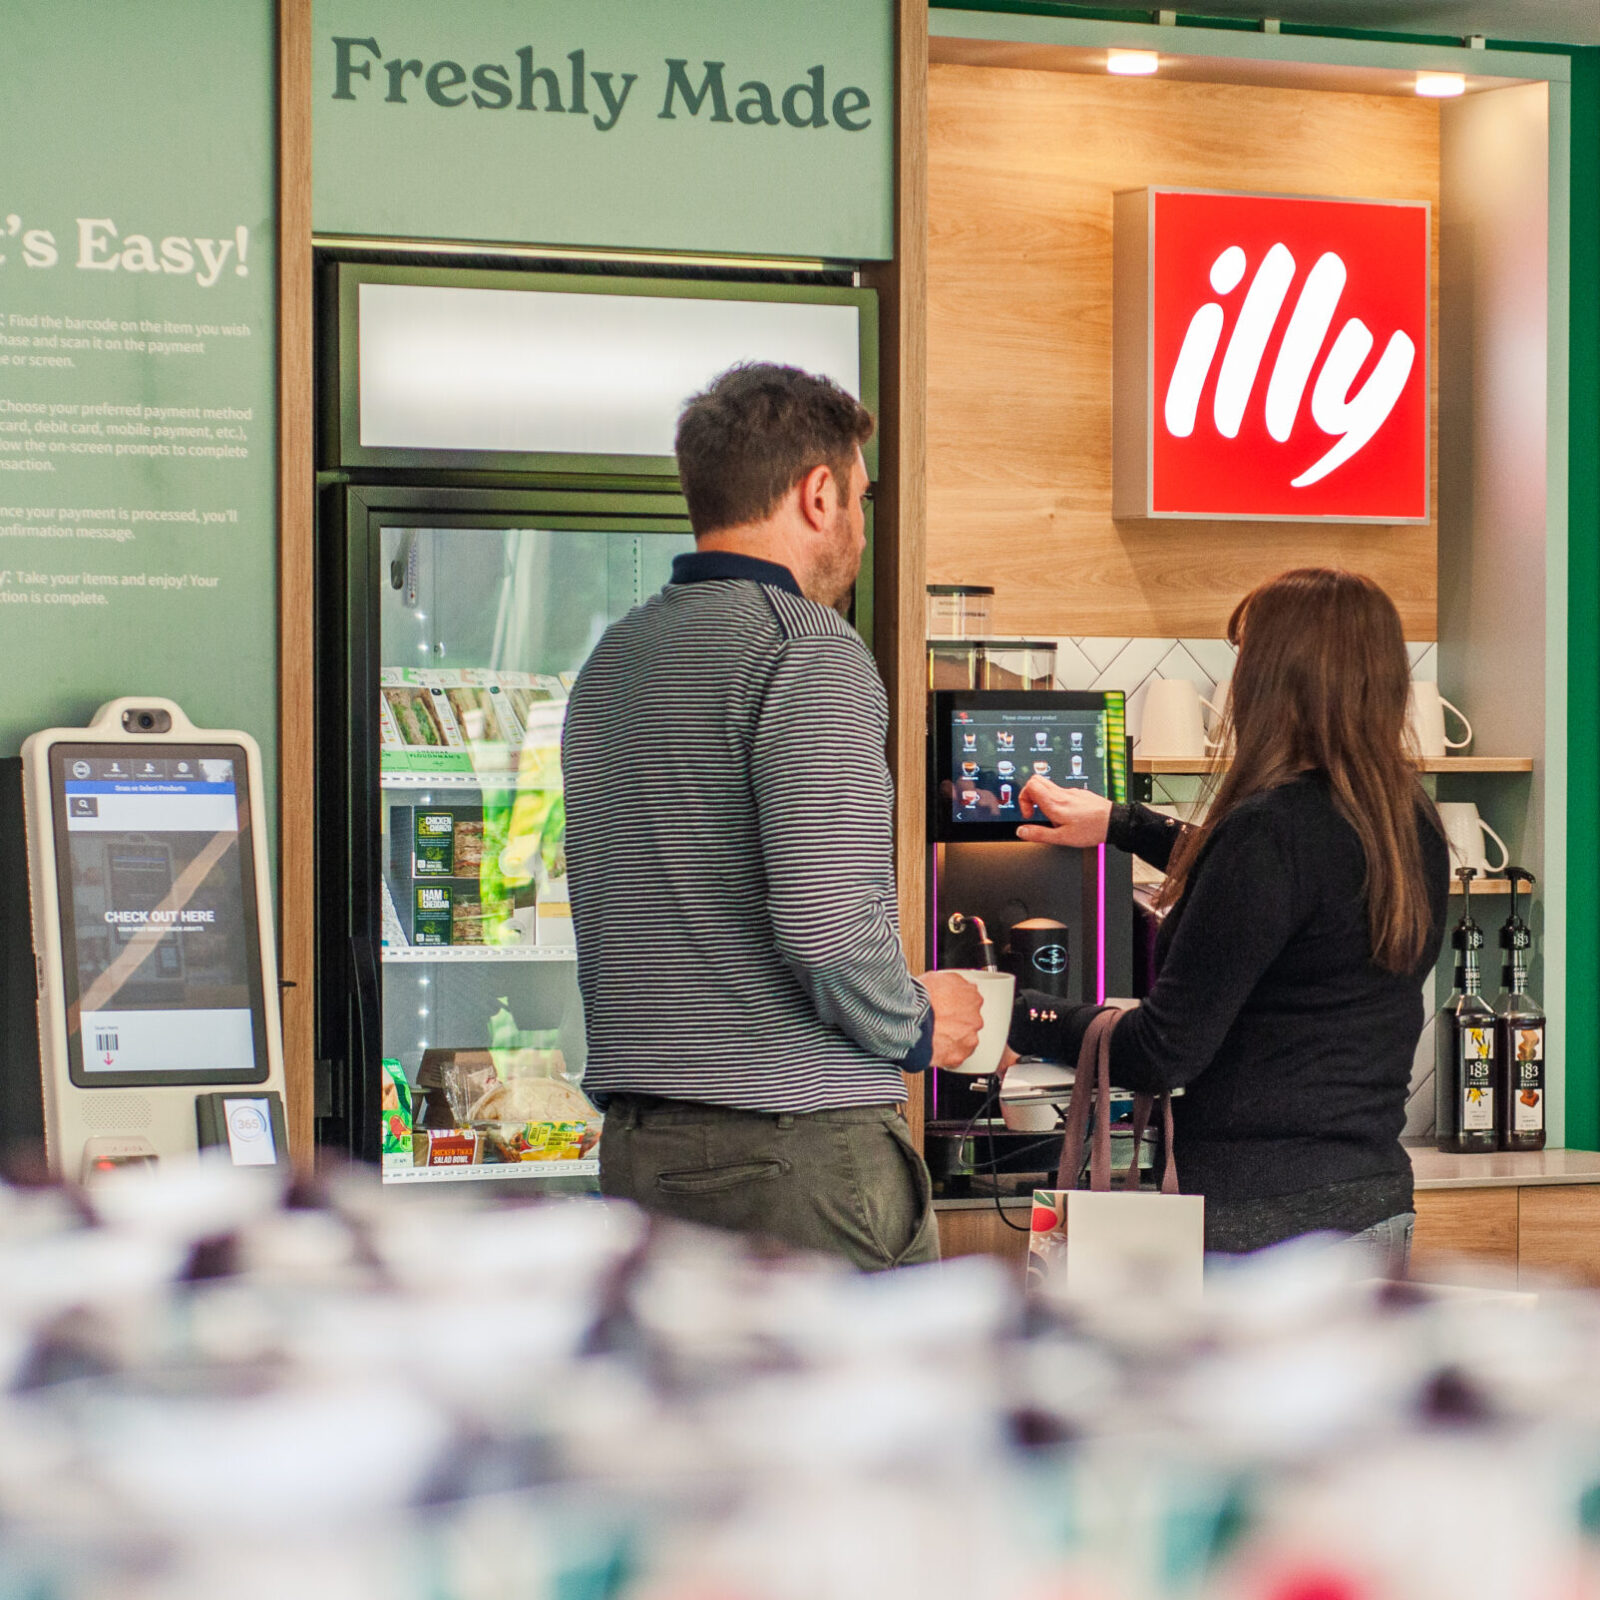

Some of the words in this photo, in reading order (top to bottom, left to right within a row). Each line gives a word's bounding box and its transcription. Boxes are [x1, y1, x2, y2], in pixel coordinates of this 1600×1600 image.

[331, 37, 637, 131] Freshly
[657, 58, 872, 130] Made
[0, 213, 58, 267] 's
[76, 218, 248, 287] Easy!
[9, 314, 38, 327] Find
[41, 315, 61, 328] the
[65, 316, 118, 330] barcode
[120, 321, 137, 330] on
[139, 320, 160, 333] the
[163, 320, 193, 334] item
[195, 324, 219, 337] you
[220, 322, 250, 336] wish
[32, 335, 57, 348] and
[60, 338, 89, 348] scan
[92, 336, 102, 350] it
[104, 340, 121, 350] on
[124, 337, 145, 351] the
[148, 342, 205, 355] payment
[11, 356, 26, 366] or
[28, 356, 75, 367] screen.
[1164, 242, 1416, 487] illy
[48, 404, 78, 417] your
[81, 402, 141, 417] preferred
[144, 407, 200, 420] payment
[203, 407, 252, 420] method
[34, 420, 68, 434] debit
[71, 422, 103, 437] card,
[106, 423, 150, 436] mobile
[153, 427, 213, 439] payment,
[24, 438, 46, 451] the
[49, 442, 113, 454] on-screen
[116, 444, 169, 457] prompts
[172, 445, 186, 456] to
[188, 446, 248, 459] complete
[25, 508, 56, 521] your
[58, 508, 115, 522] payment
[119, 507, 129, 520] is
[131, 509, 200, 523] processed,
[76, 528, 136, 542] message.
[16, 571, 48, 584] Take
[50, 575, 79, 587] your
[82, 572, 119, 585] items
[121, 573, 146, 585] and
[148, 573, 187, 590] enjoy!
[190, 574, 219, 587] Your
[30, 591, 41, 604] is
[43, 592, 109, 607] complete.
[423, 889, 443, 900] HAM
[104, 910, 149, 922] CHECK
[151, 910, 177, 922] OUT
[181, 910, 215, 922] HERE
[238, 1119, 259, 1130] 365
[433, 1156, 452, 1164] SALAD
[453, 1155, 469, 1163] BOWL
